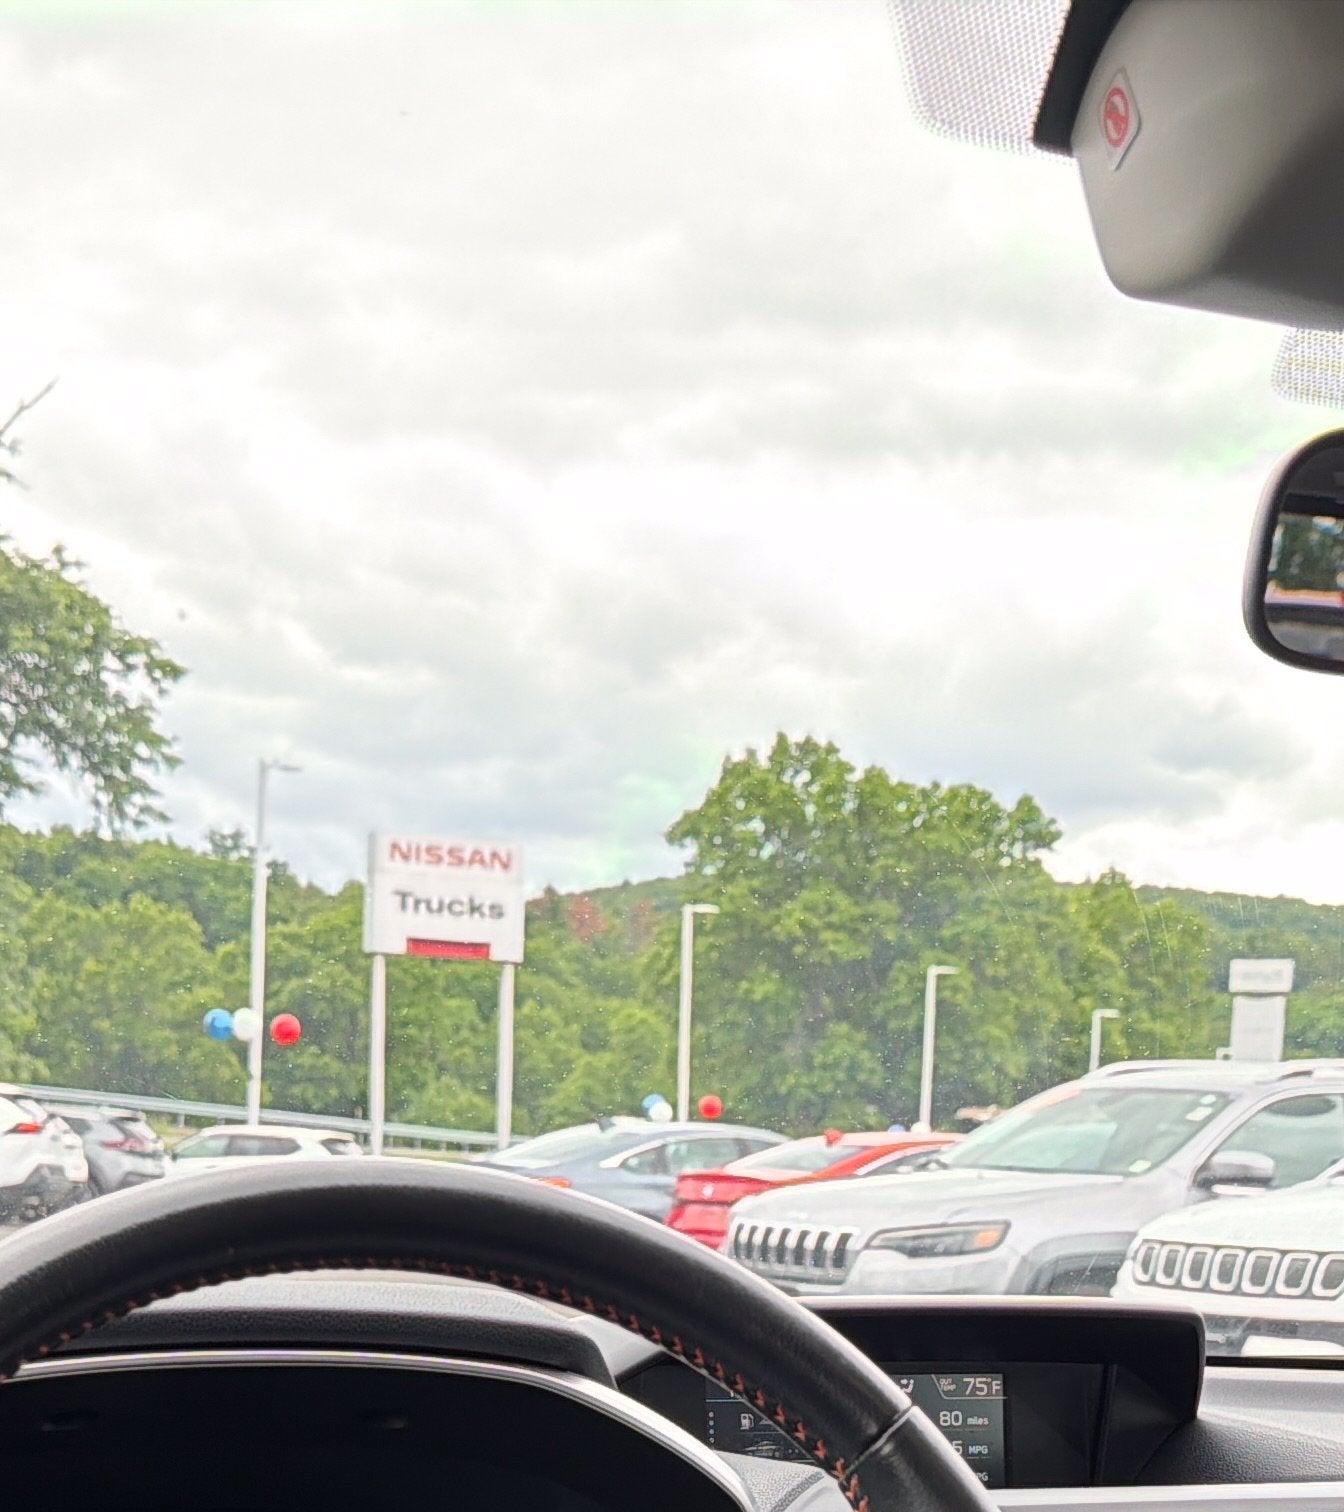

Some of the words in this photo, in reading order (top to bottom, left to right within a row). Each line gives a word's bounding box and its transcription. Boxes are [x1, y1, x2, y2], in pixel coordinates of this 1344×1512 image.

[388, 840, 513, 872] NISSAN
[393, 889, 505, 919] Trucks
[939, 1411, 963, 1426] 80
[967, 1416, 989, 1425] miles
[968, 1445, 989, 1455] MPG
[975, 1472, 989, 1482] PG
